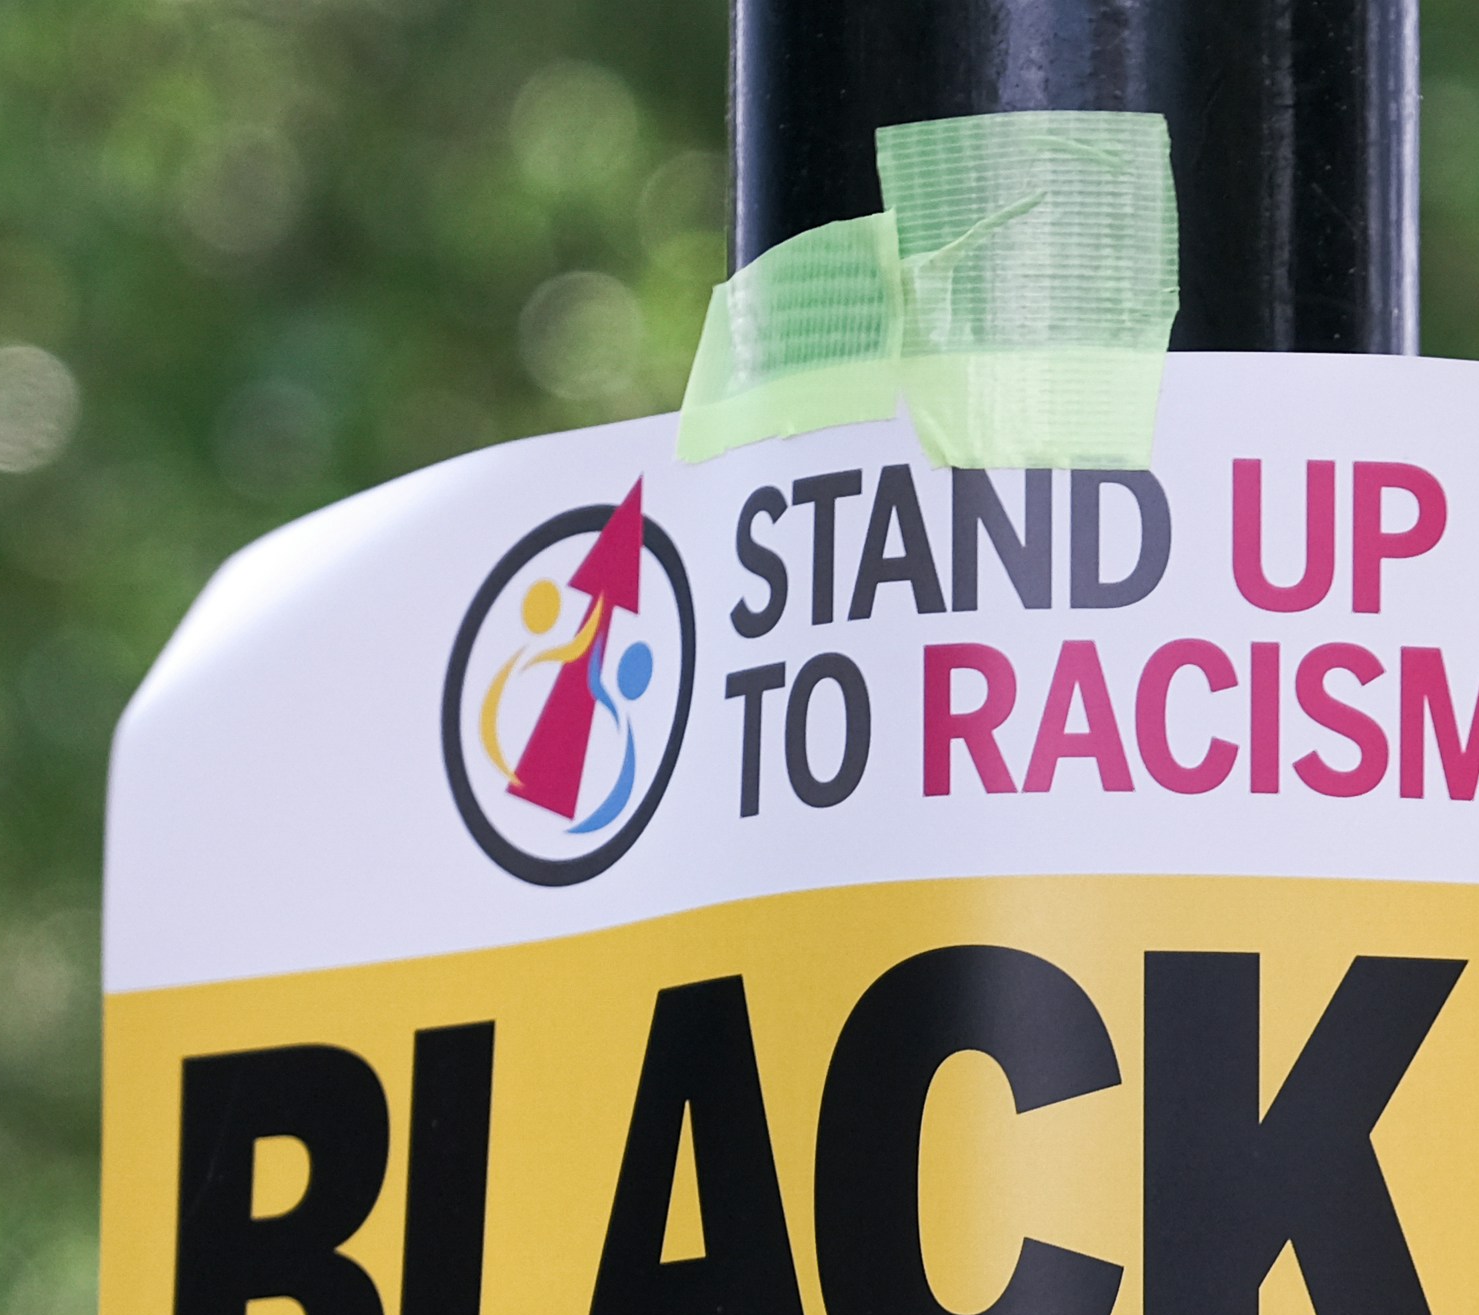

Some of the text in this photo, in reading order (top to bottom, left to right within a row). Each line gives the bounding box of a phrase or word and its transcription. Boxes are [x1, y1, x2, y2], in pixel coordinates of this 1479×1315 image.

[728, 458, 1448, 639] STAND UP
[725, 650, 872, 819] TO
